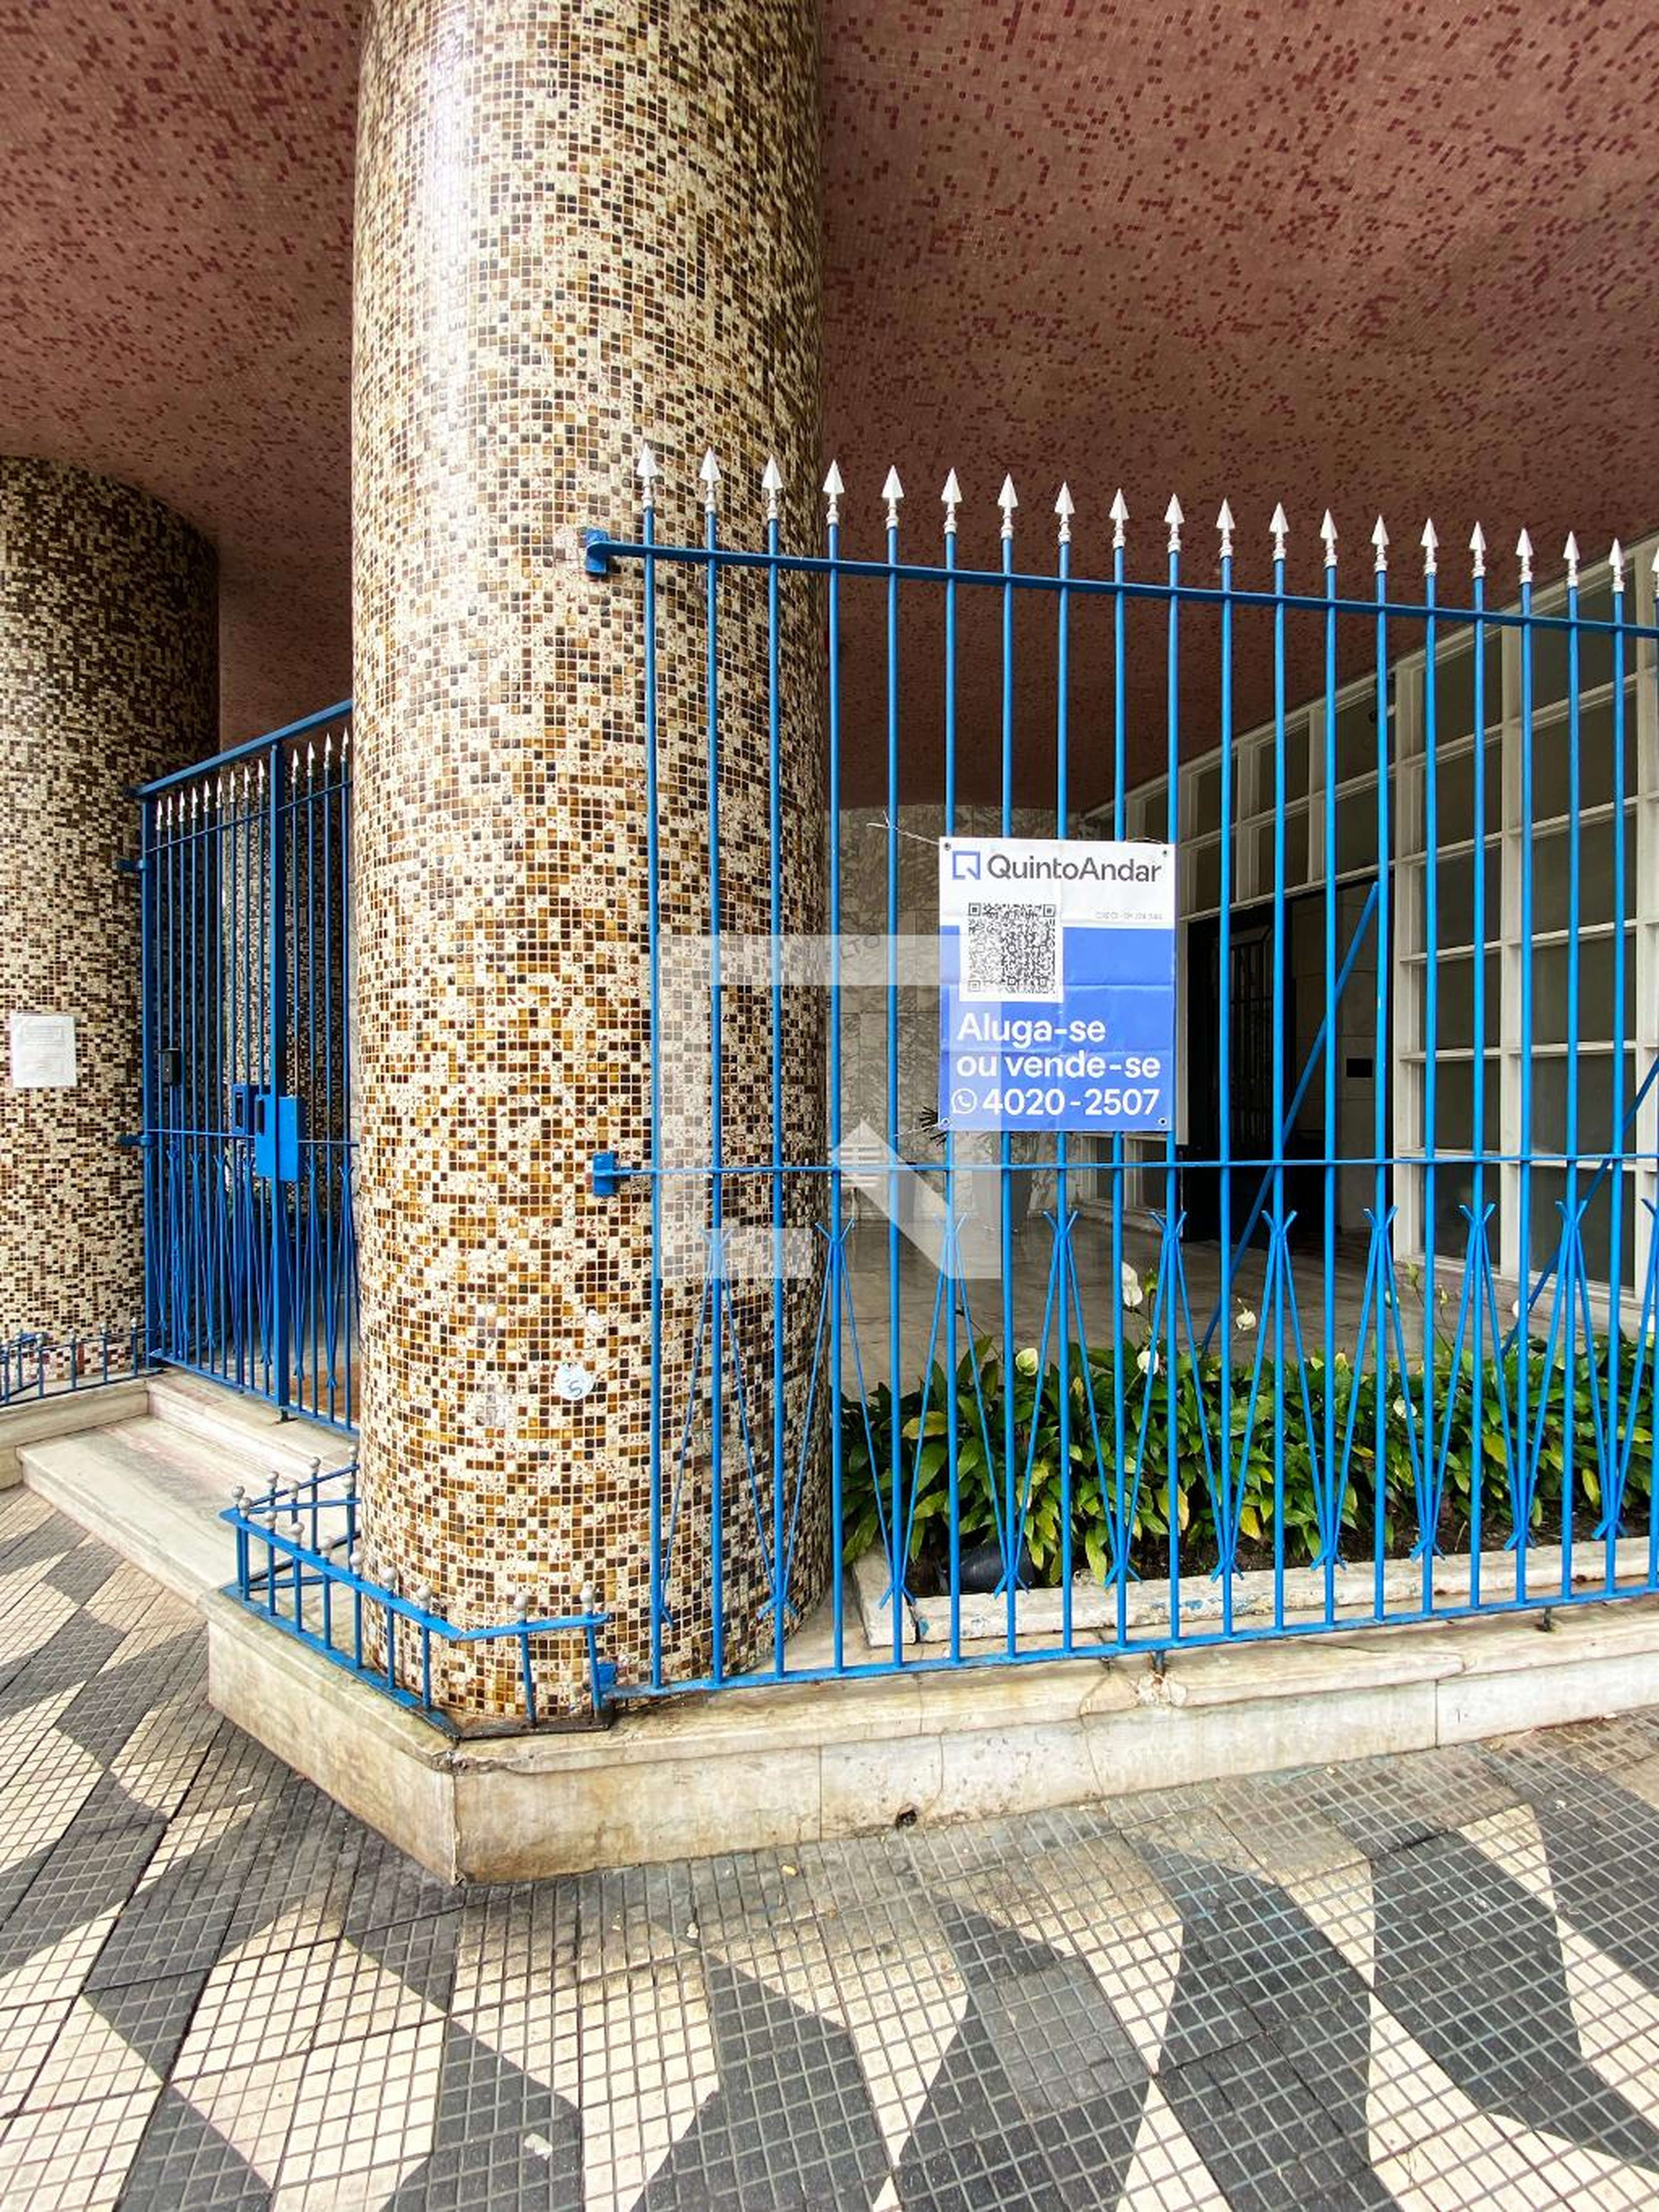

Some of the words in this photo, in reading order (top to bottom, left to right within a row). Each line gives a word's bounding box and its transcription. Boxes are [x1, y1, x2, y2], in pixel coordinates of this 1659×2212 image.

[987, 854, 1162, 882] QuintoAndar
[957, 1013, 1106, 1049] Aluga-se
[957, 1057, 997, 1077] ou
[1005, 1050, 1161, 1078] vende-se
[982, 1088, 1160, 1116] 4020-2507
